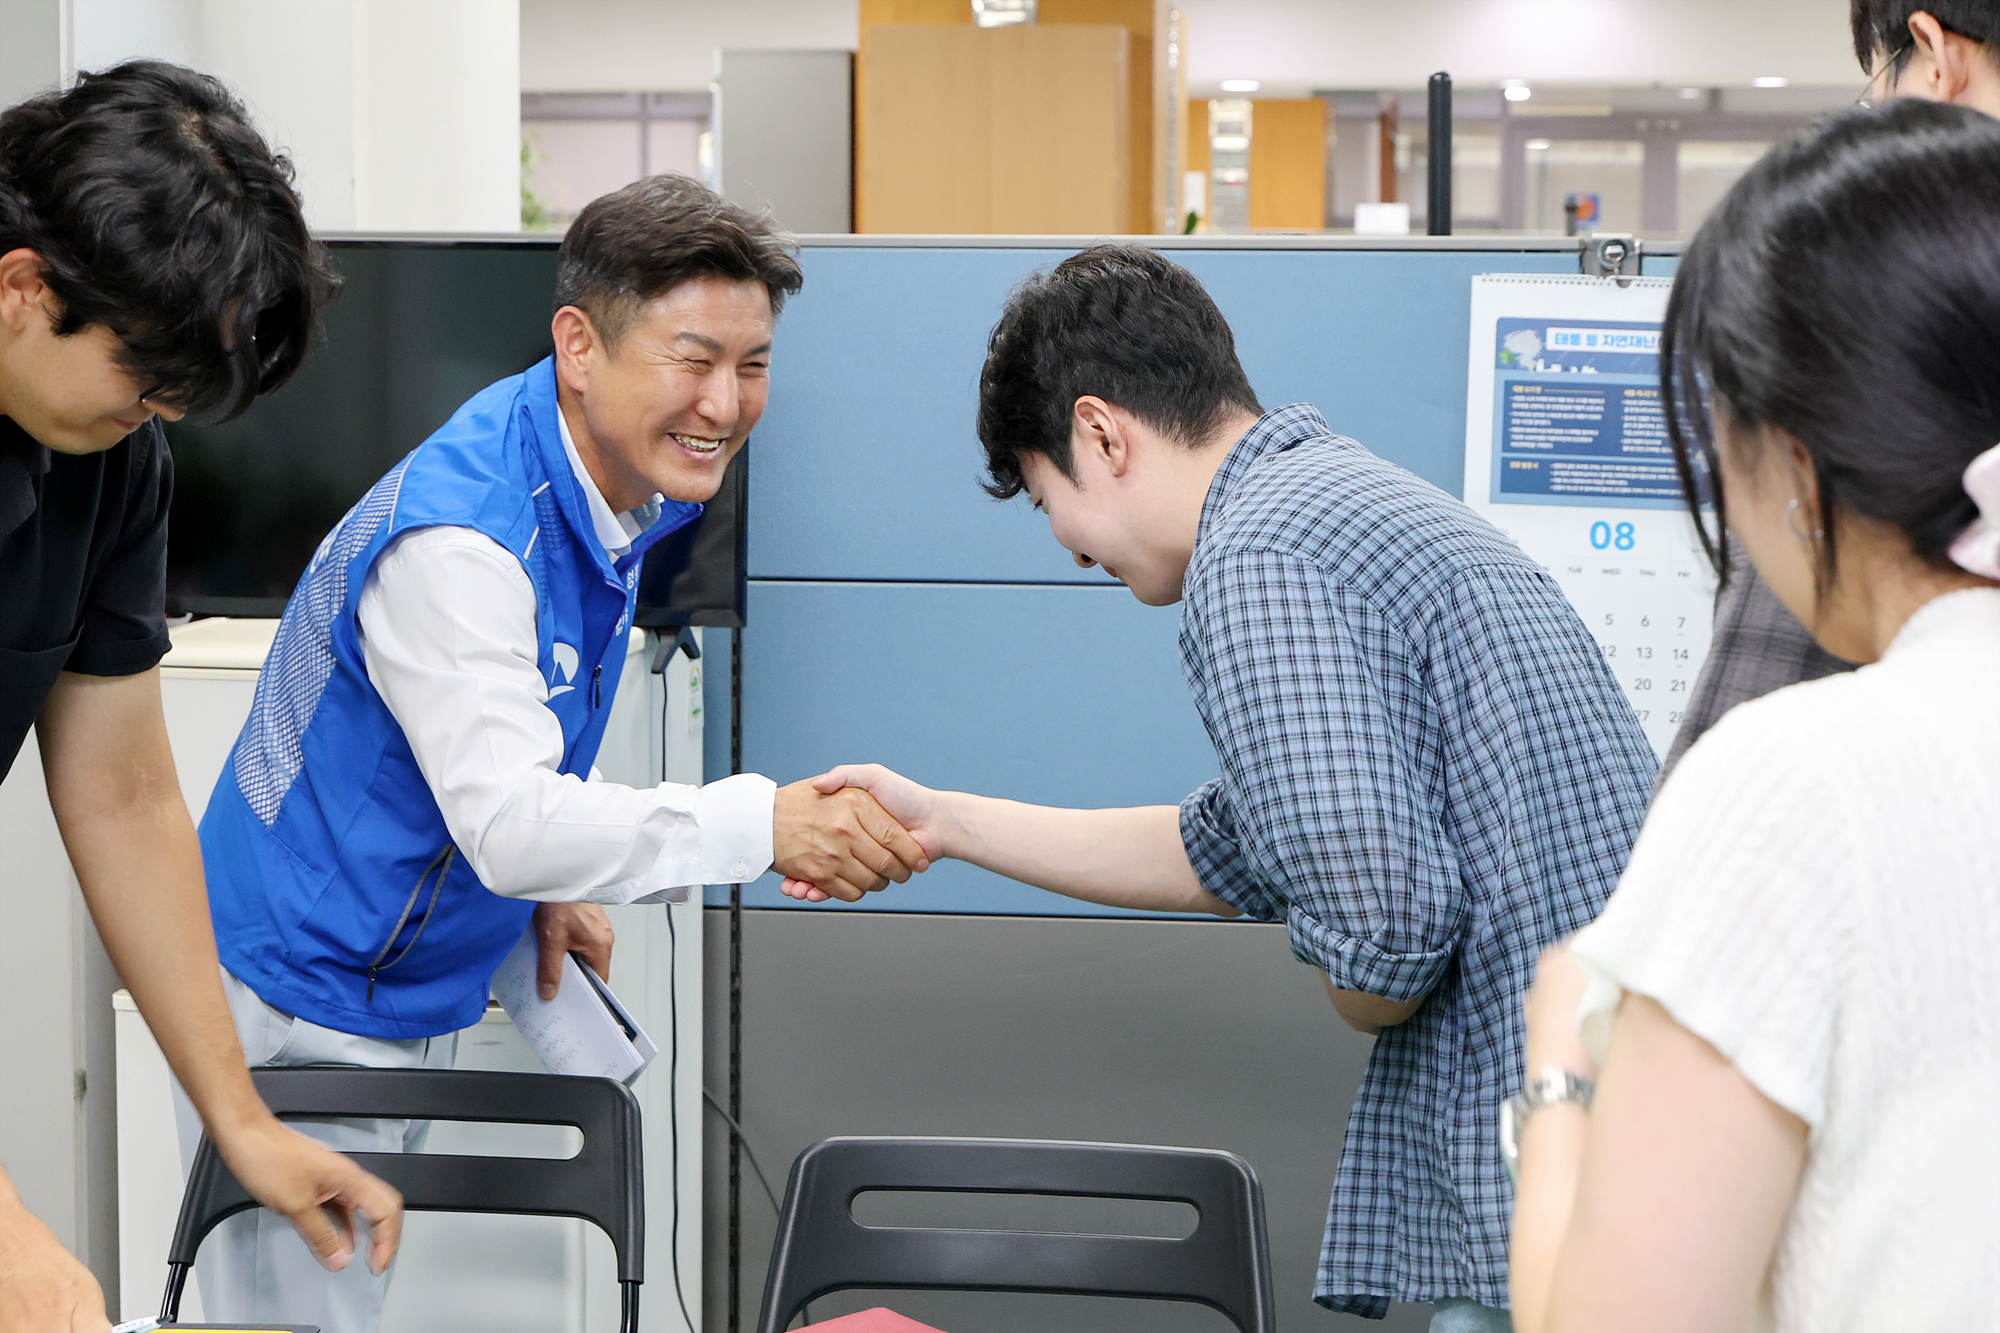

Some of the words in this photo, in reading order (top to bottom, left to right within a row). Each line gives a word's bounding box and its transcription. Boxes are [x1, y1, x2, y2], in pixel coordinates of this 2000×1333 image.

[1555, 332, 1581, 346] 태풍
[1587, 333, 1598, 347] 등
[1603, 334, 1656, 349] 자연재난
[1590, 520, 1636, 551] 08
[1605, 613, 1614, 626] 5
[1641, 614, 1651, 628] 6
[1677, 616, 1687, 629] 7
[1601, 645, 1617, 658] 12
[1637, 646, 1653, 659] 13
[1672, 648, 1688, 660] 14
[1635, 677, 1652, 690] 20
[1671, 679, 1686, 692] 21
